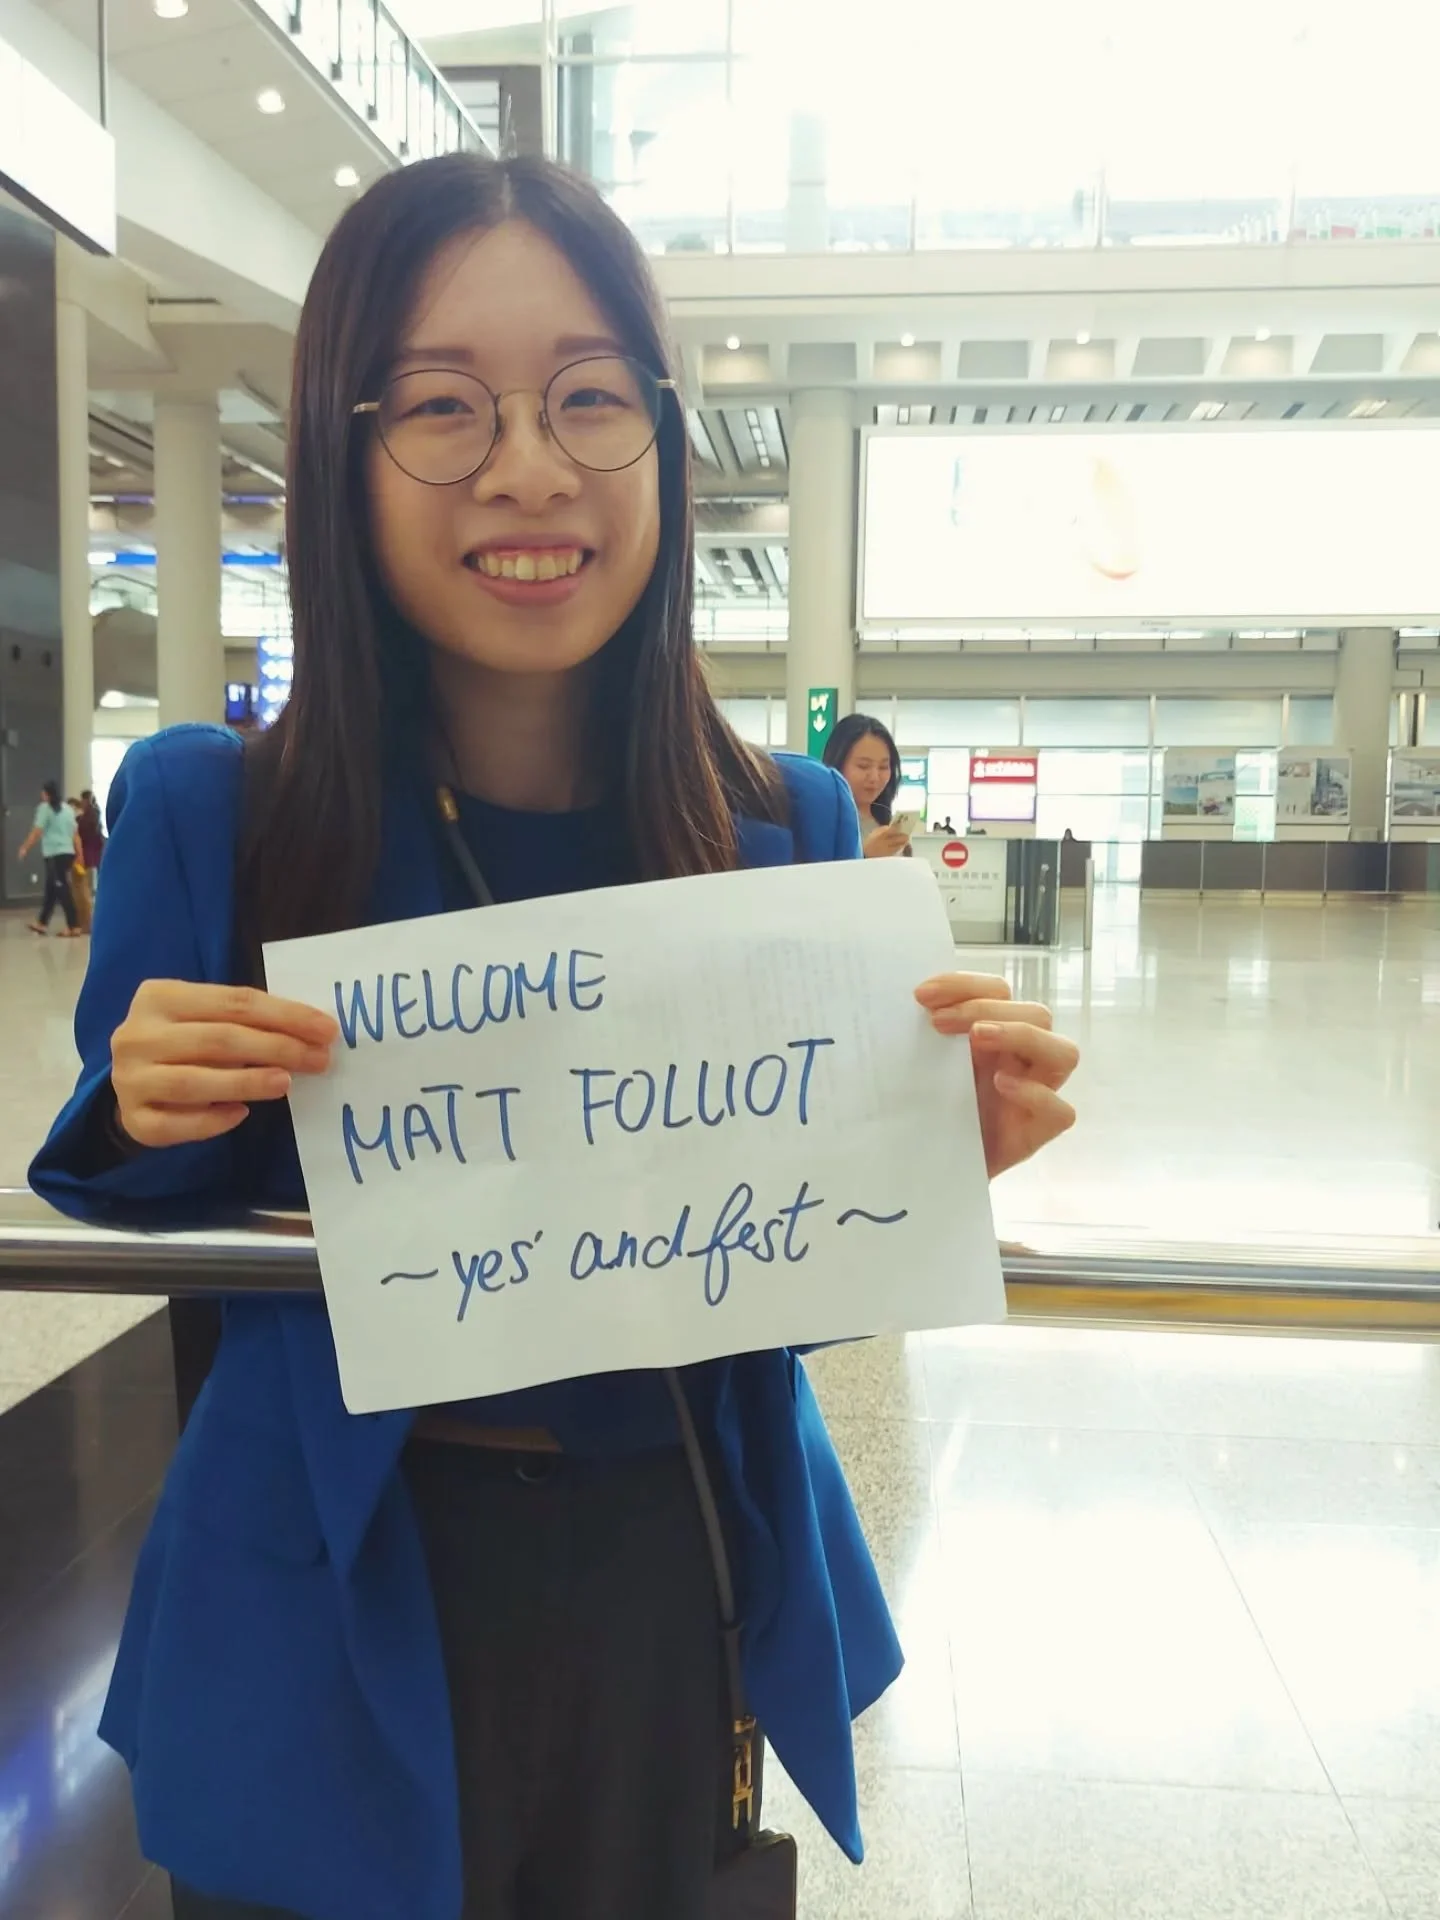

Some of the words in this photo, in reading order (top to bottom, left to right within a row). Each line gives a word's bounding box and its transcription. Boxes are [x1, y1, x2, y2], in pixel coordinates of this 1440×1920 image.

[334, 950, 605, 1048] WELCOME
[342, 1084, 522, 1184] MATT
[569, 1037, 835, 1146] FOLLIOT
[571, 1204, 691, 1281] and
